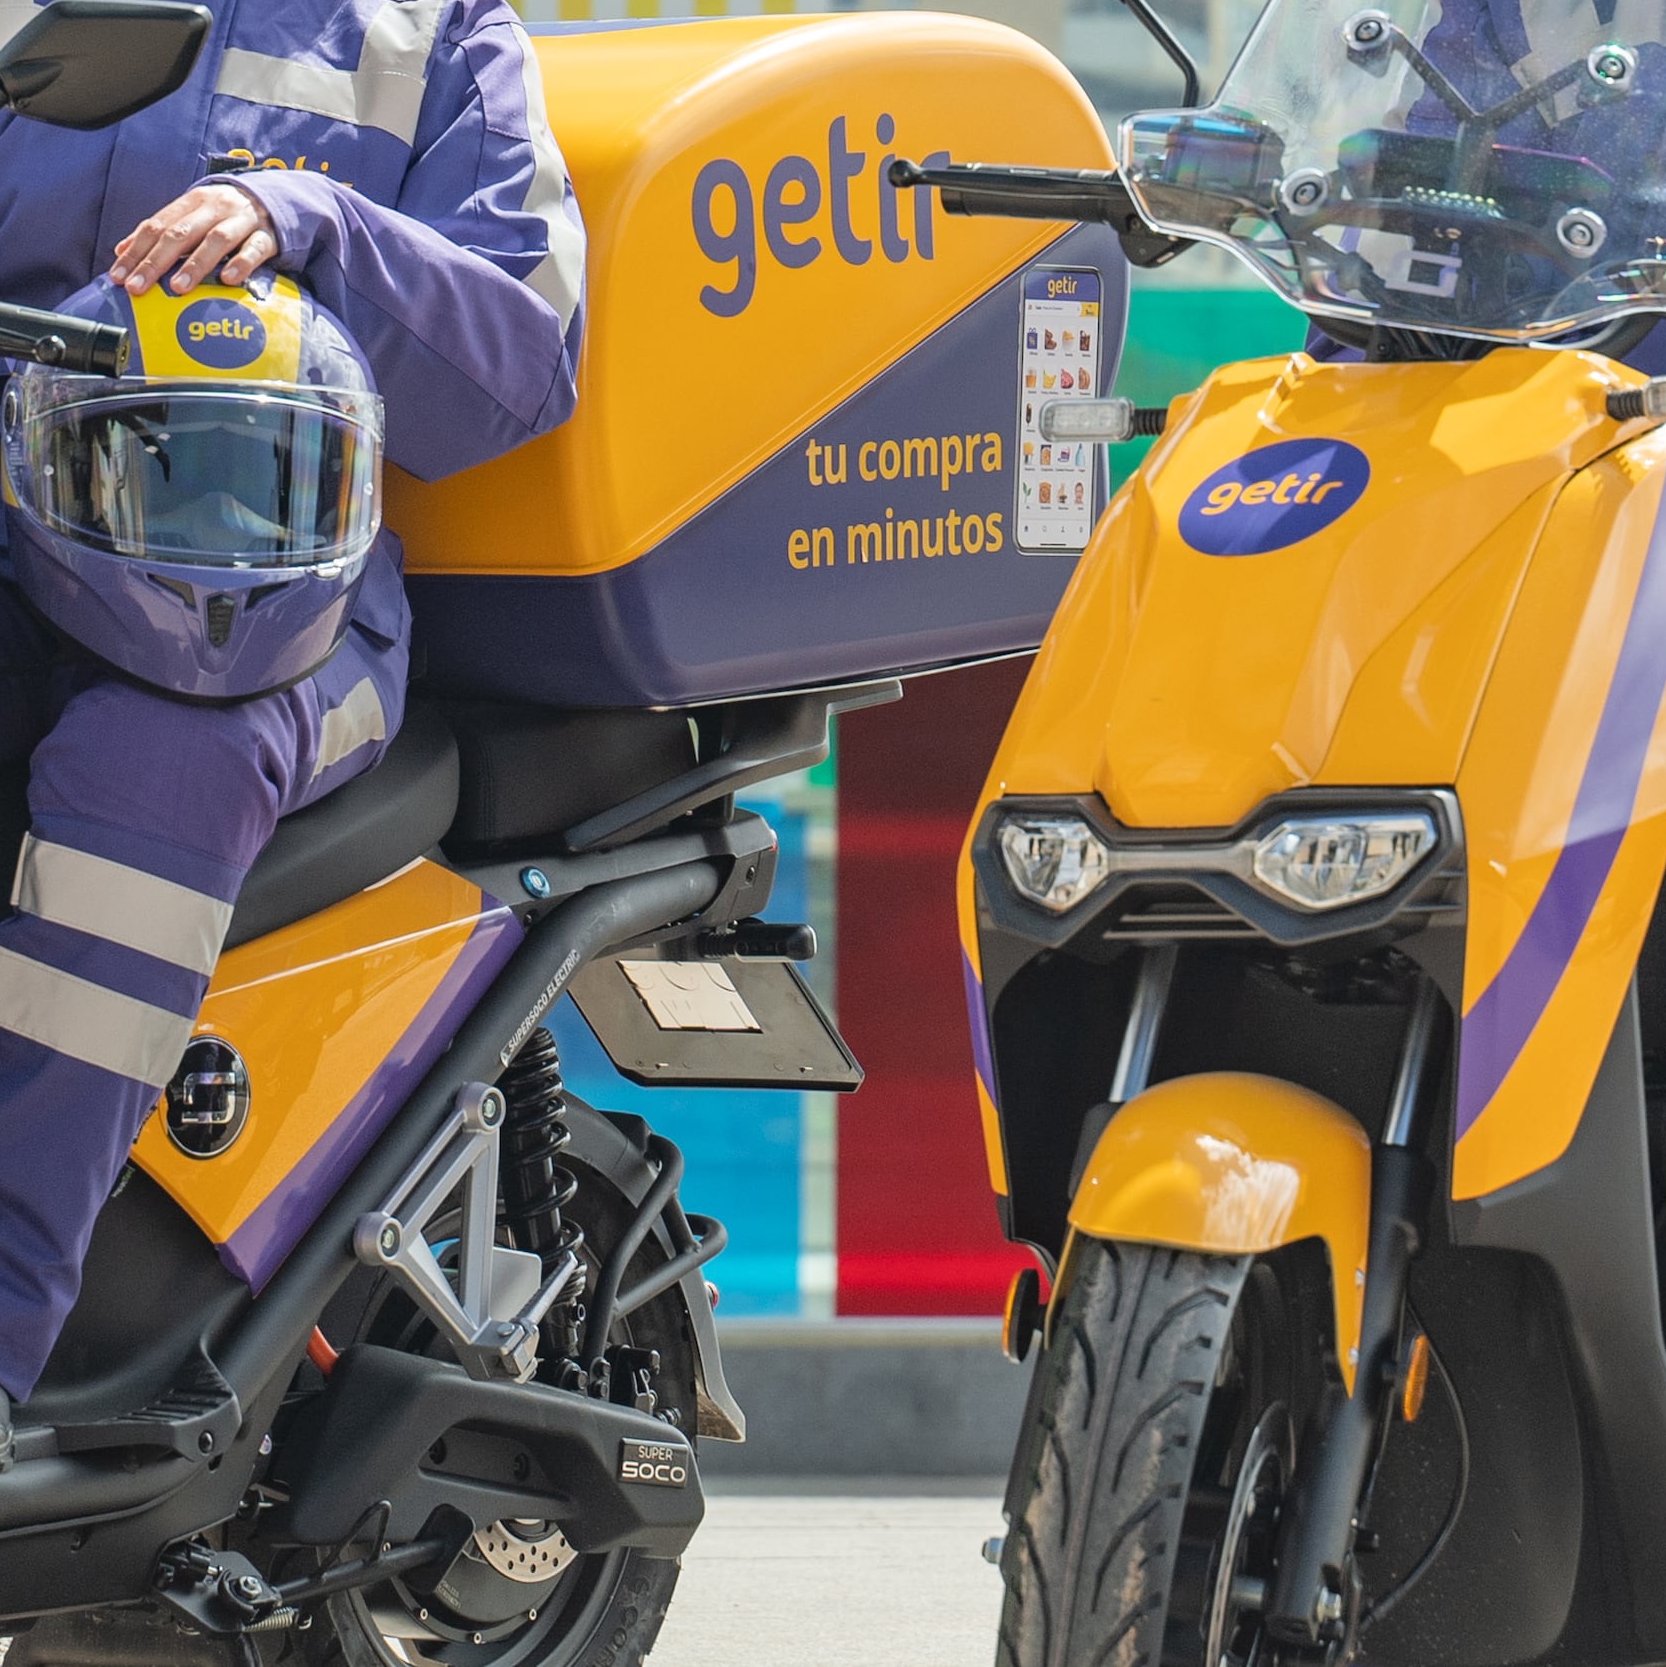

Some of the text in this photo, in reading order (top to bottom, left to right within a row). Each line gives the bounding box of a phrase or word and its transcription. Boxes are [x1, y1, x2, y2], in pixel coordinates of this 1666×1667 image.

[1047, 275, 1078, 298] getir
[188, 318, 254, 342] getir
[805, 429, 1003, 491] tu compra
[1199, 472, 1344, 516] getir
[787, 509, 1004, 570] en minutos
[507, 948, 581, 1052] SUPERSOCO ELECTRIC
[638, 1445, 673, 1461] SUPER
[621, 1460, 686, 1483] SOCO
